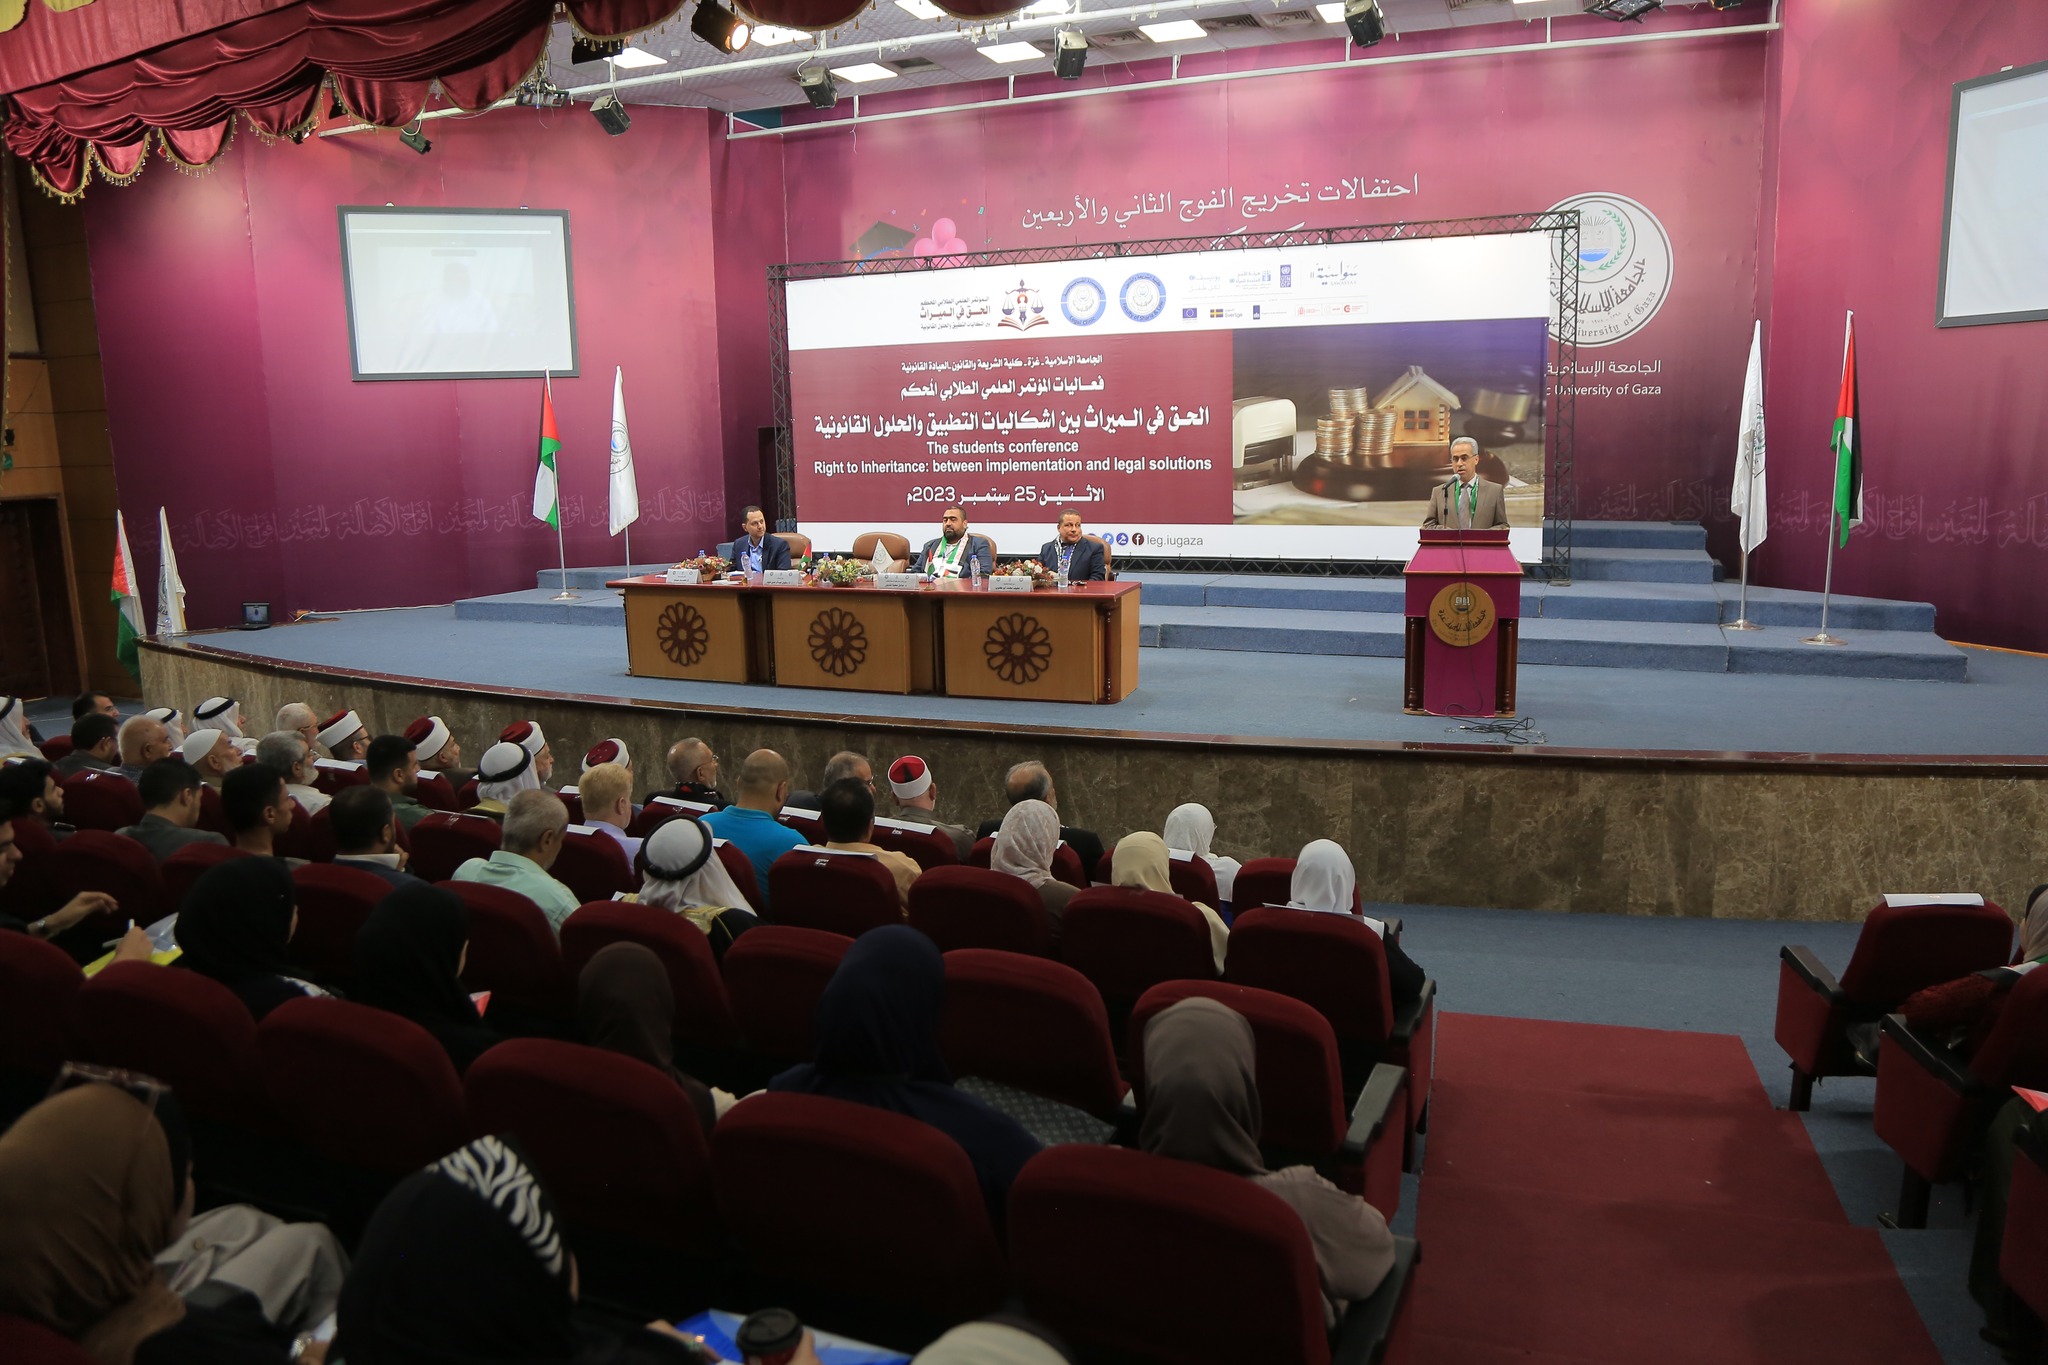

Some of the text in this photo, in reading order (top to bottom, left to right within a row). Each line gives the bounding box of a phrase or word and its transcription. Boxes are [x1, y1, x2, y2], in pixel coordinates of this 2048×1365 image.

[1021, 172, 1419, 230] احتفالات تخريج الفوج الثاني والأربعين
[920, 305, 991, 321] الحق في الميراث
[901, 361, 928, 374] القانونية
[977, 357, 1003, 371] الشريعة
[1003, 357, 1023, 369] كلية
[1027, 356, 1041, 369] غزة
[1045, 355, 1076, 368] الإسلامية
[1077, 354, 1103, 366] الجامعة
[1608, 359, 1661, 376] الجامعة
[940, 379, 979, 401] الطلابي
[981, 378, 1016, 400] العلمي
[1017, 376, 1051, 397] المؤتمر
[1052, 374, 1105, 396] فعاليات
[1616, 383, 1630, 395] of
[1632, 384, 1662, 395] Gaza
[814, 403, 1211, 439] الحق في الميراث بين اشكاليات التطبيق والحلول القانونية
[926, 439, 1080, 455] The students conference
[814, 455, 1212, 476] Right to Inheritance: between implementation and legal solutions
[906, 484, 1105, 506] الاثنين 25 سبتمبر 2023م
[1147, 534, 1204, 548] leg.iugaza
